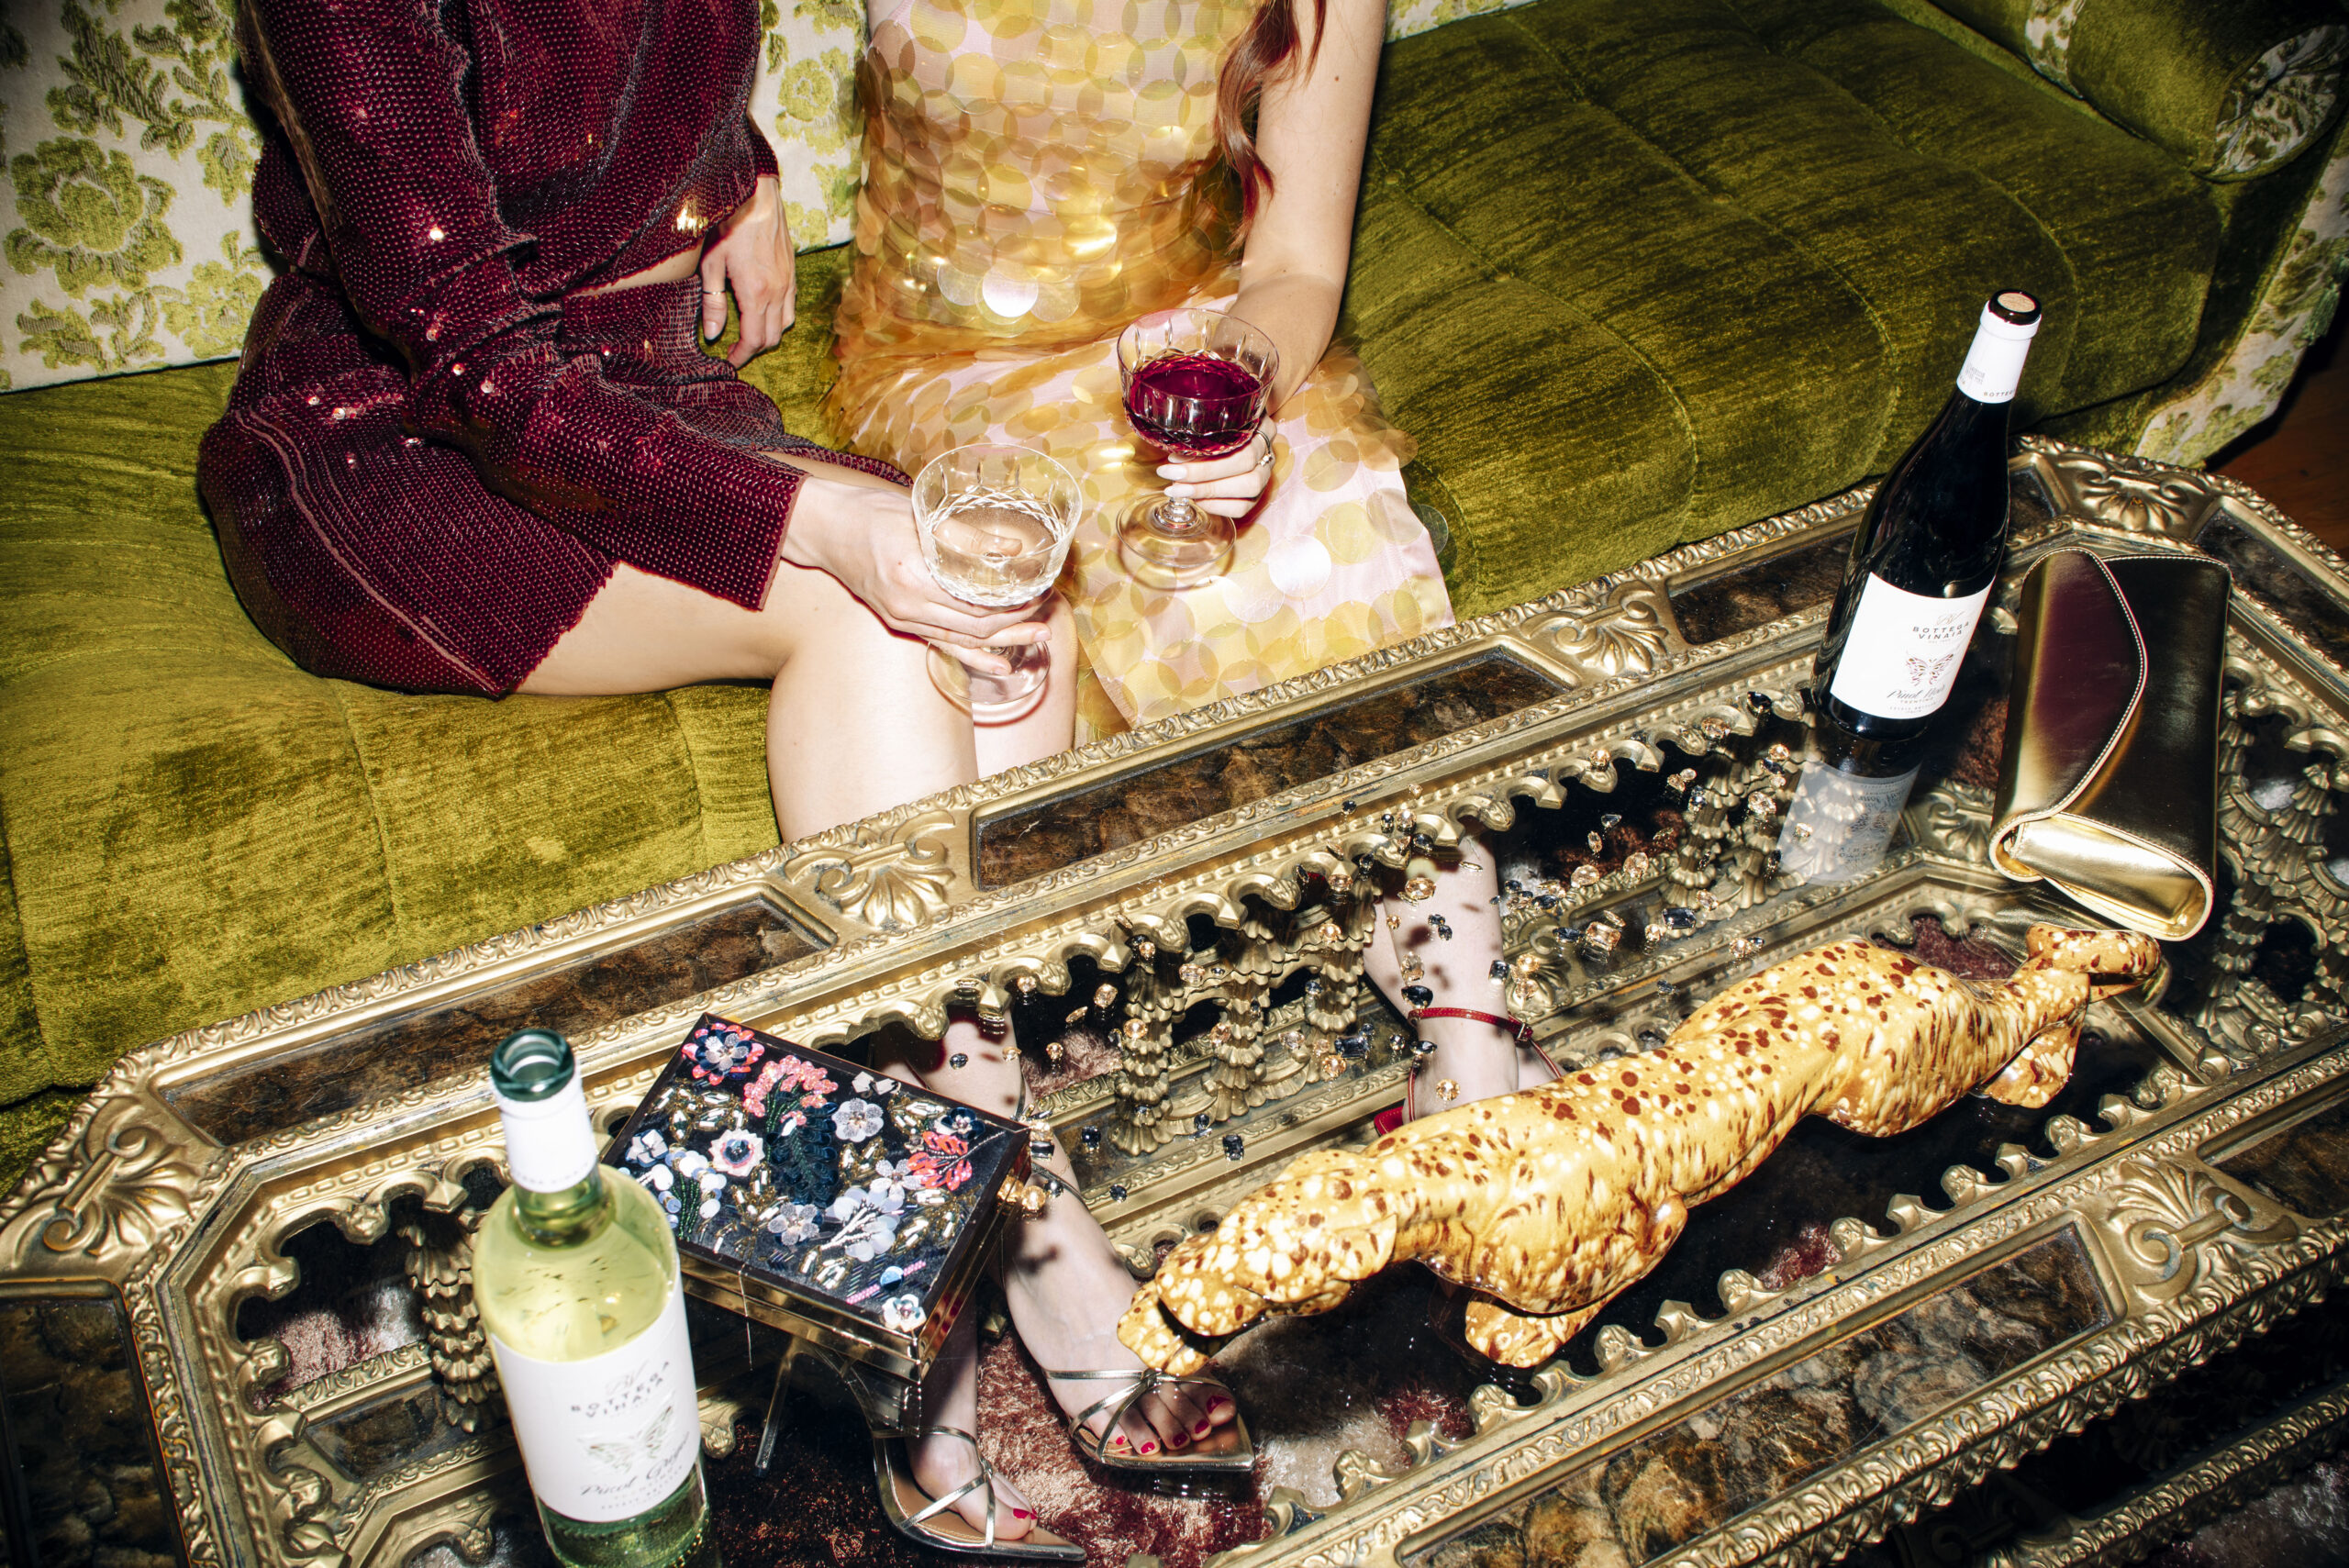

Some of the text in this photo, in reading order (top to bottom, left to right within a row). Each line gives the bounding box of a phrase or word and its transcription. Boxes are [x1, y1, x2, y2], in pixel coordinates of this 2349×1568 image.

[1912, 621, 1969, 633] BOTTEGA
[1919, 629, 1962, 639] VINAIA
[1887, 689, 1923, 699] Pinot
[571, 1361, 670, 1412] BOTTEGA
